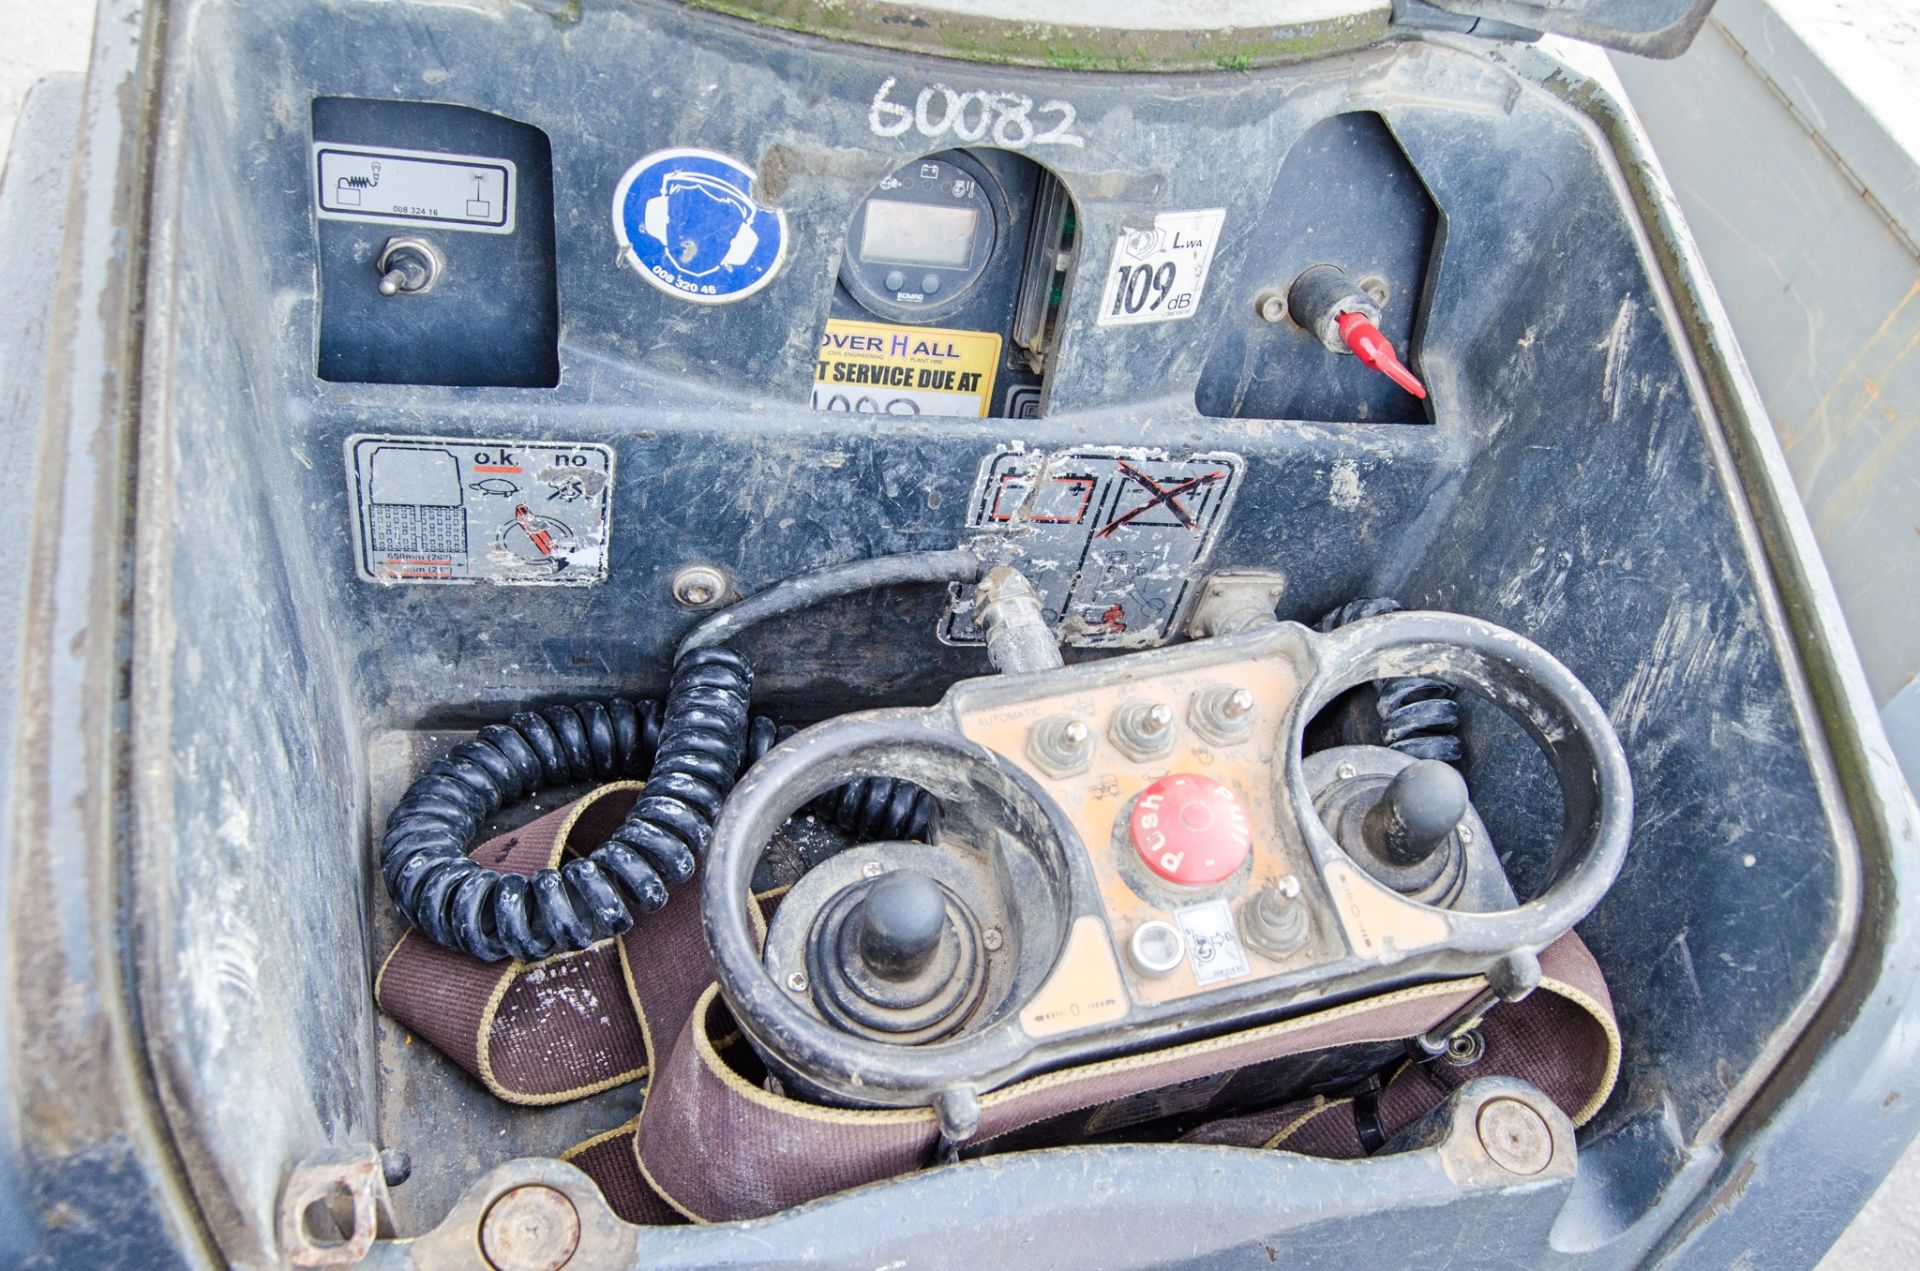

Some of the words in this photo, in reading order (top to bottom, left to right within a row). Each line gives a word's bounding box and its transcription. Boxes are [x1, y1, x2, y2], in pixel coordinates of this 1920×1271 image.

[868, 76, 1085, 148] 60082
[392, 205, 408, 213] 008
[410, 206, 426, 215] 324
[429, 208, 439, 216] 16
[652, 265, 675, 283] 008
[675, 278, 698, 292] 320
[700, 285, 717, 294] 46
[1112, 261, 1176, 316] 109
[1167, 293, 1192, 310] dB
[833, 362, 914, 387] SERVICE
[917, 368, 956, 389] DUE
[957, 372, 982, 392] AT
[555, 454, 587, 467] no
